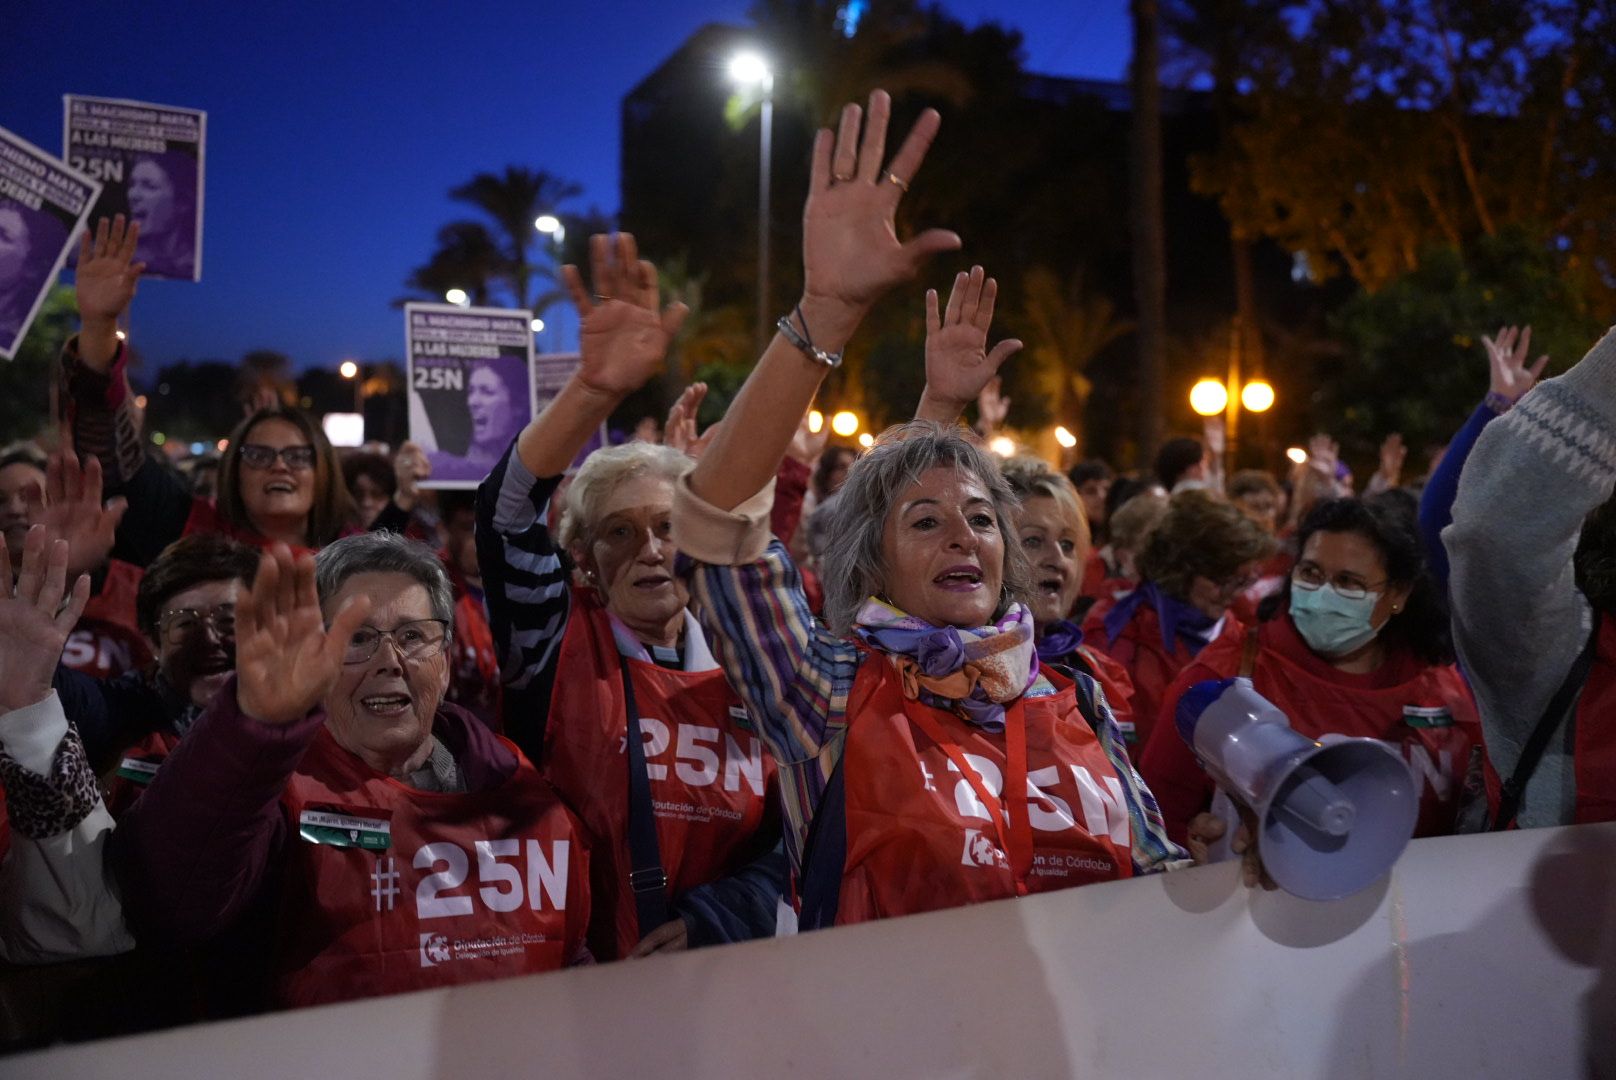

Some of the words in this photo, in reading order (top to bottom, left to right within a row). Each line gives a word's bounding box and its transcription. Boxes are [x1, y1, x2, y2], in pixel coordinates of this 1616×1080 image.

[71, 156, 124, 182] 25N
[414, 366, 464, 391] 25N
[1036, 867, 1069, 877] Igualdad
[1048, 854, 1063, 867] de
[1065, 855, 1112, 871] Córdoba
[370, 839, 570, 920] #25N
[454, 936, 507, 952] Diputación
